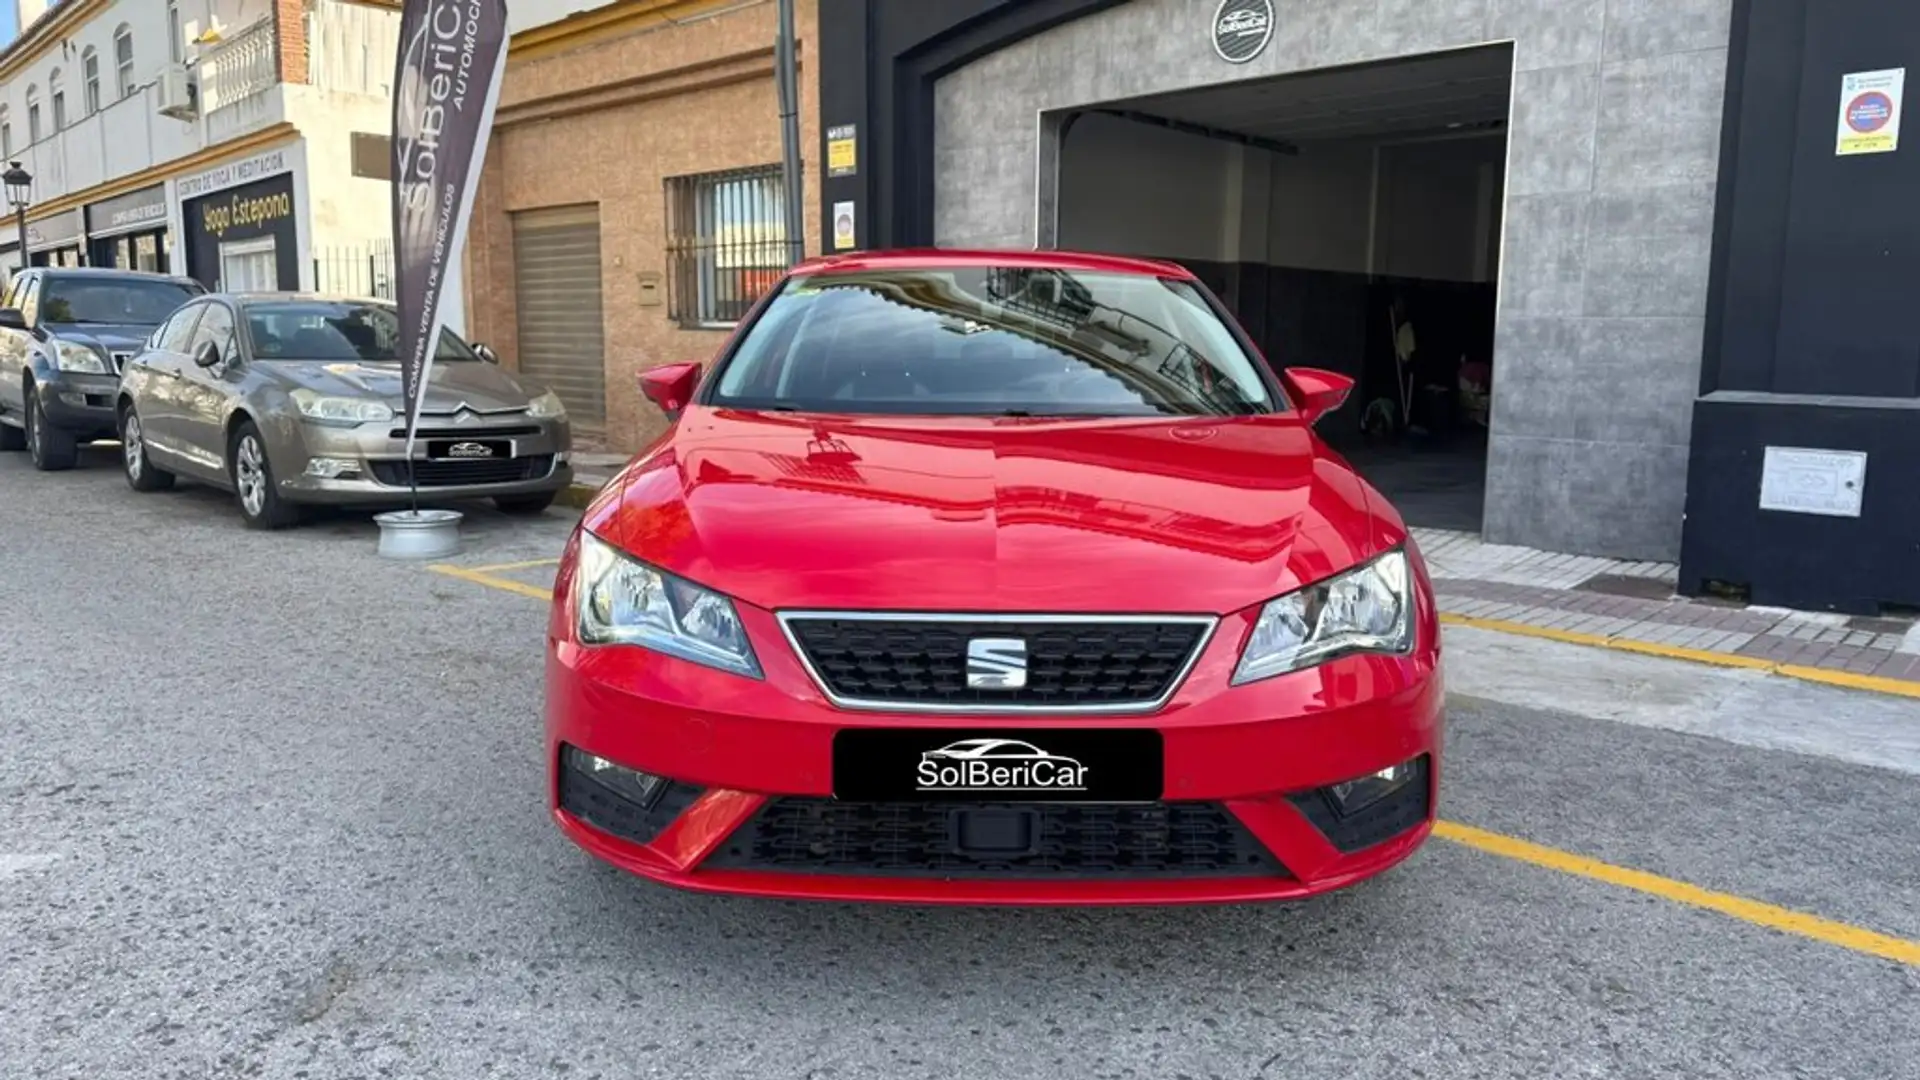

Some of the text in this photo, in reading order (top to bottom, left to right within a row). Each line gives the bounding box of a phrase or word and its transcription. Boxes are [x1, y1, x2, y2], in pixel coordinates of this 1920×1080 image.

[408, 0, 461, 211] SolBeriC
[453, 0, 482, 111] AUTOMOCI
[232, 192, 289, 228] Estepona
[409, 336, 424, 398] COMPRA
[420, 290, 434, 333] VENTA
[429, 264, 440, 286] DE
[917, 761, 1089, 786] SolBeriCar
